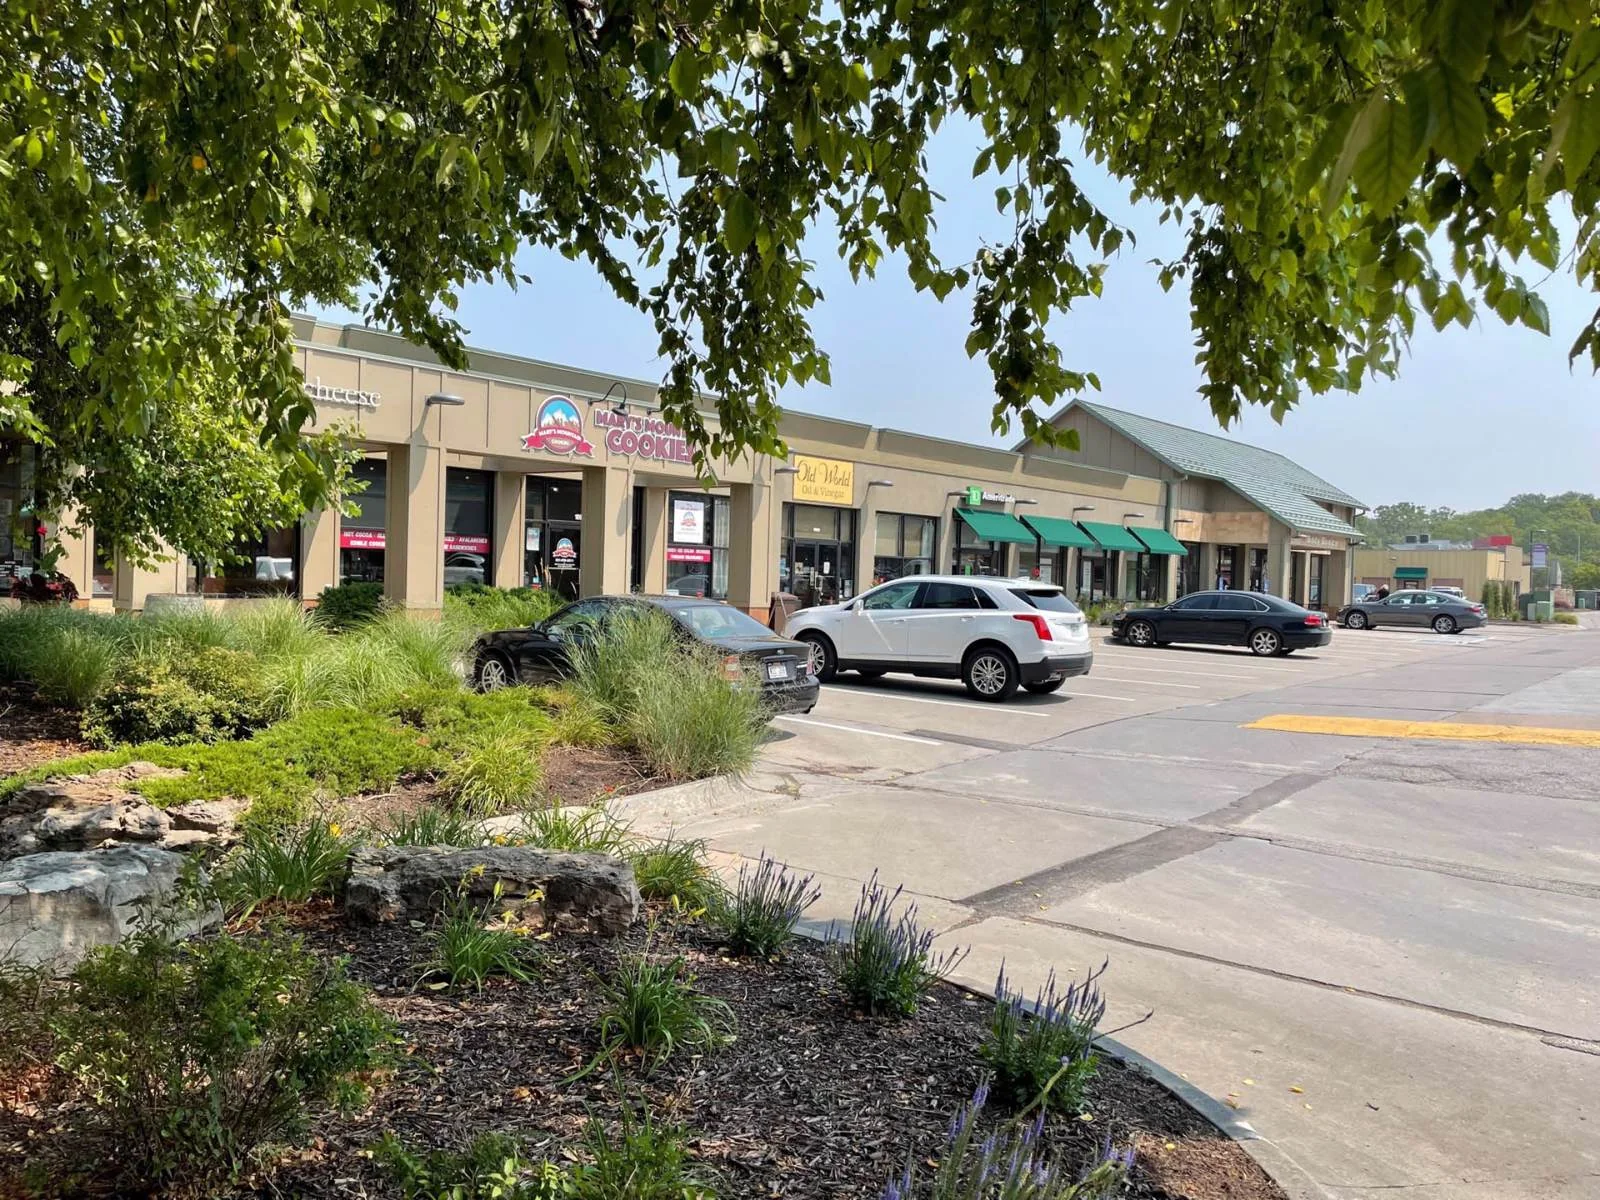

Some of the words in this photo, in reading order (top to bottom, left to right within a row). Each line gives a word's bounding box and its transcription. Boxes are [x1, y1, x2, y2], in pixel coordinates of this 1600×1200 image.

[304, 376, 382, 407] cheese
[594, 408, 643, 433] MARY'S
[797, 460, 817, 483] Old
[818, 462, 851, 487] World
